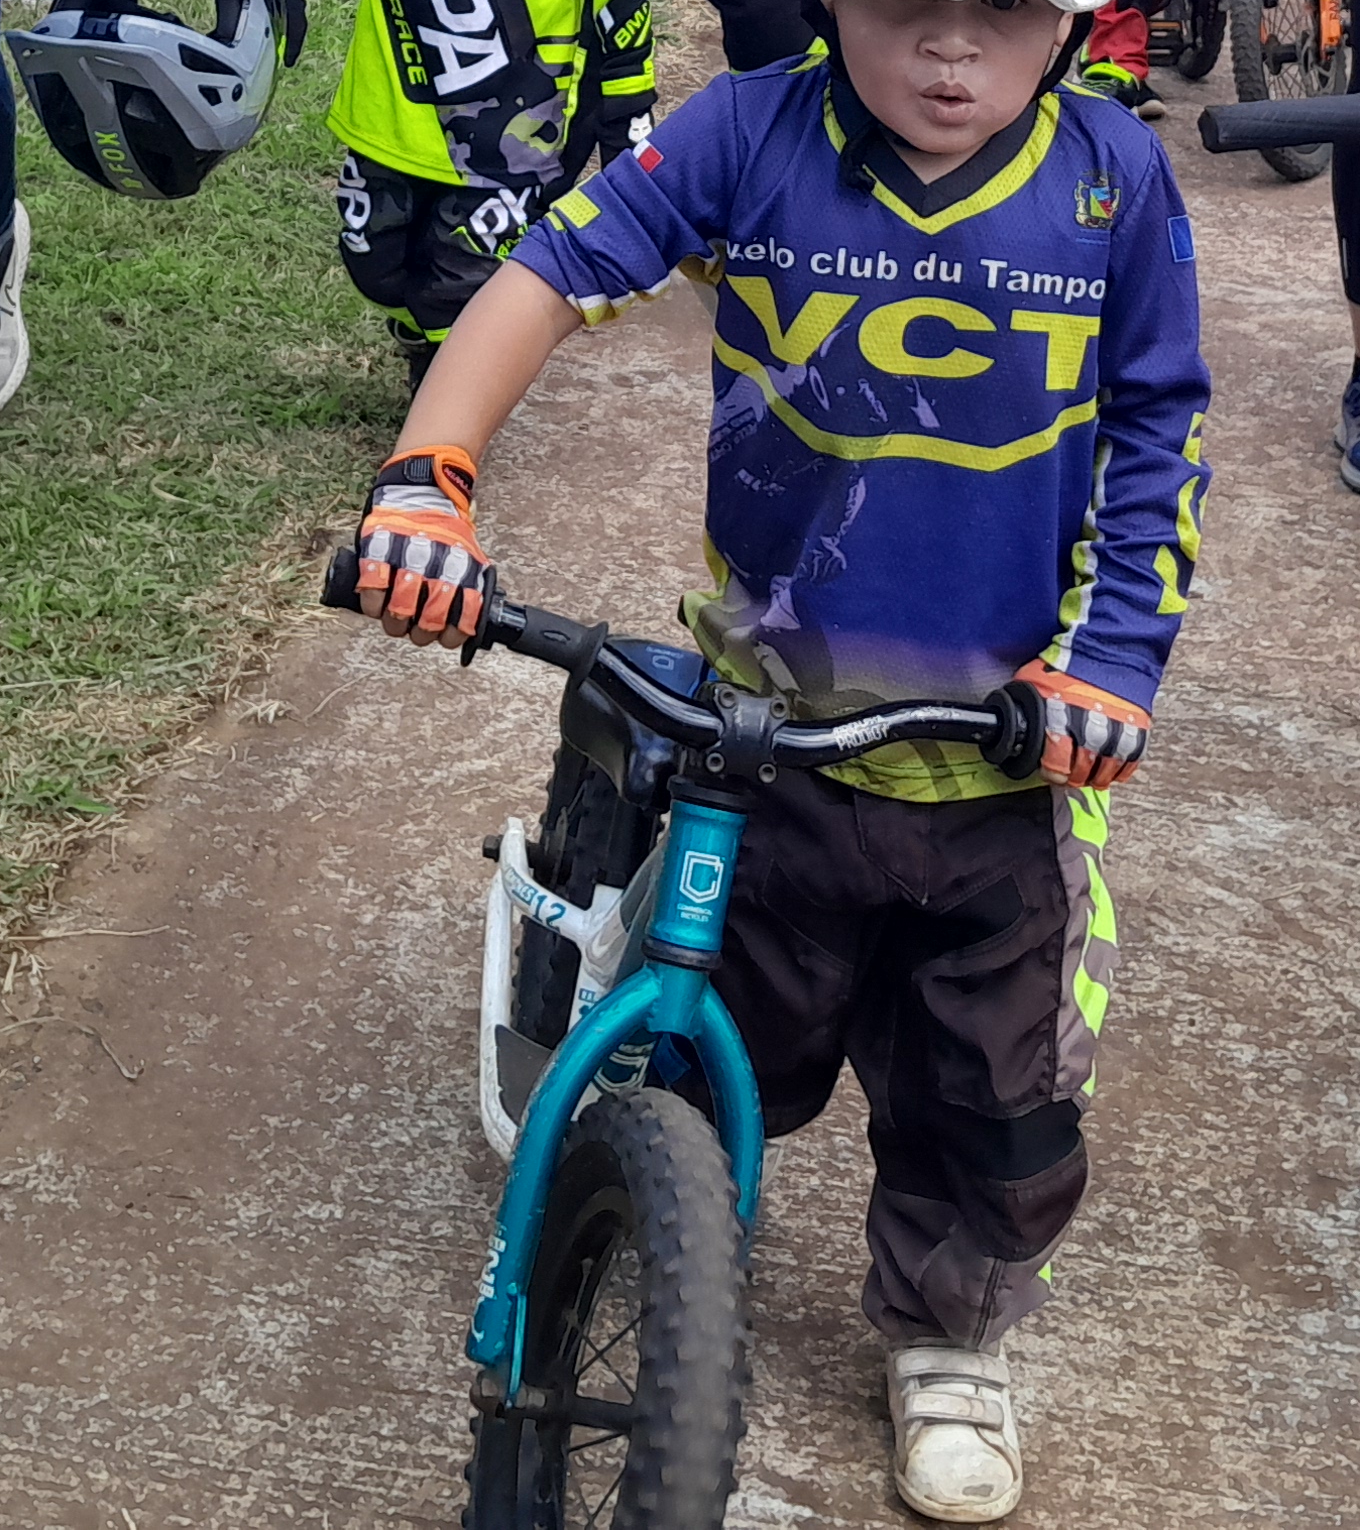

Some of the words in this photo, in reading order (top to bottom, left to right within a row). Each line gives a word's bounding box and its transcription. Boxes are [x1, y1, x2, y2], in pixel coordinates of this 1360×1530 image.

[93, 130, 134, 174] FOX
[809, 247, 899, 281] club
[913, 252, 962, 285] du
[981, 258, 1107, 304] Tampo
[727, 274, 1102, 392] VCT
[530, 893, 567, 934] 12
